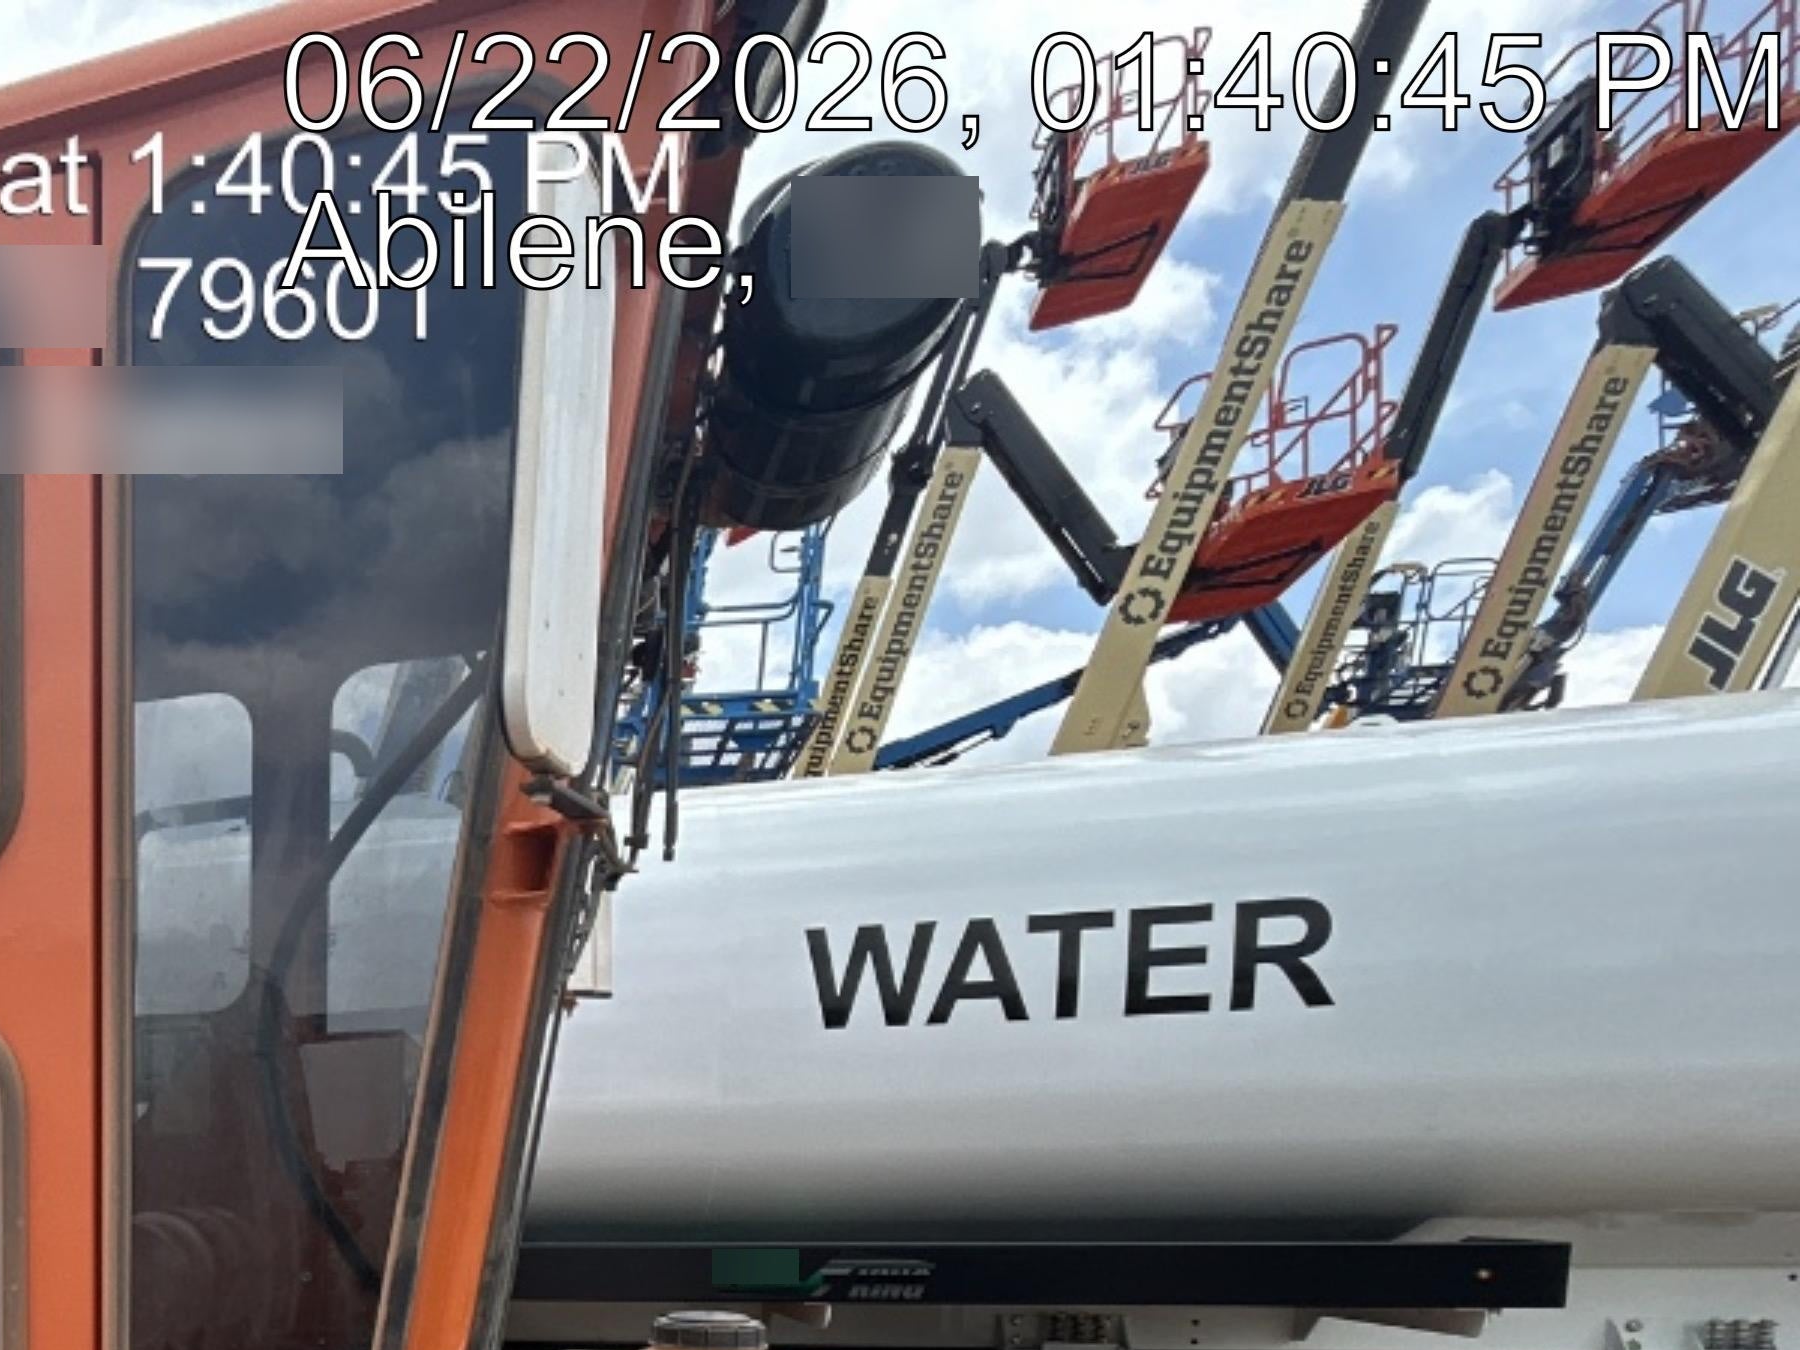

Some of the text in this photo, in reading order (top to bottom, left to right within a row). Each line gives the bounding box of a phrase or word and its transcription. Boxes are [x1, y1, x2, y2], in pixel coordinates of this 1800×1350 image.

[1139, 238, 1314, 581] EquipmentShare
[1295, 474, 1349, 498] JLG
[857, 470, 964, 722] EquipmentShare
[1479, 375, 1629, 661] EquipmentShare
[1295, 520, 1381, 696] EquipmentShare
[1685, 555, 1782, 691] JLG
[804, 896, 1336, 1030] WATER
